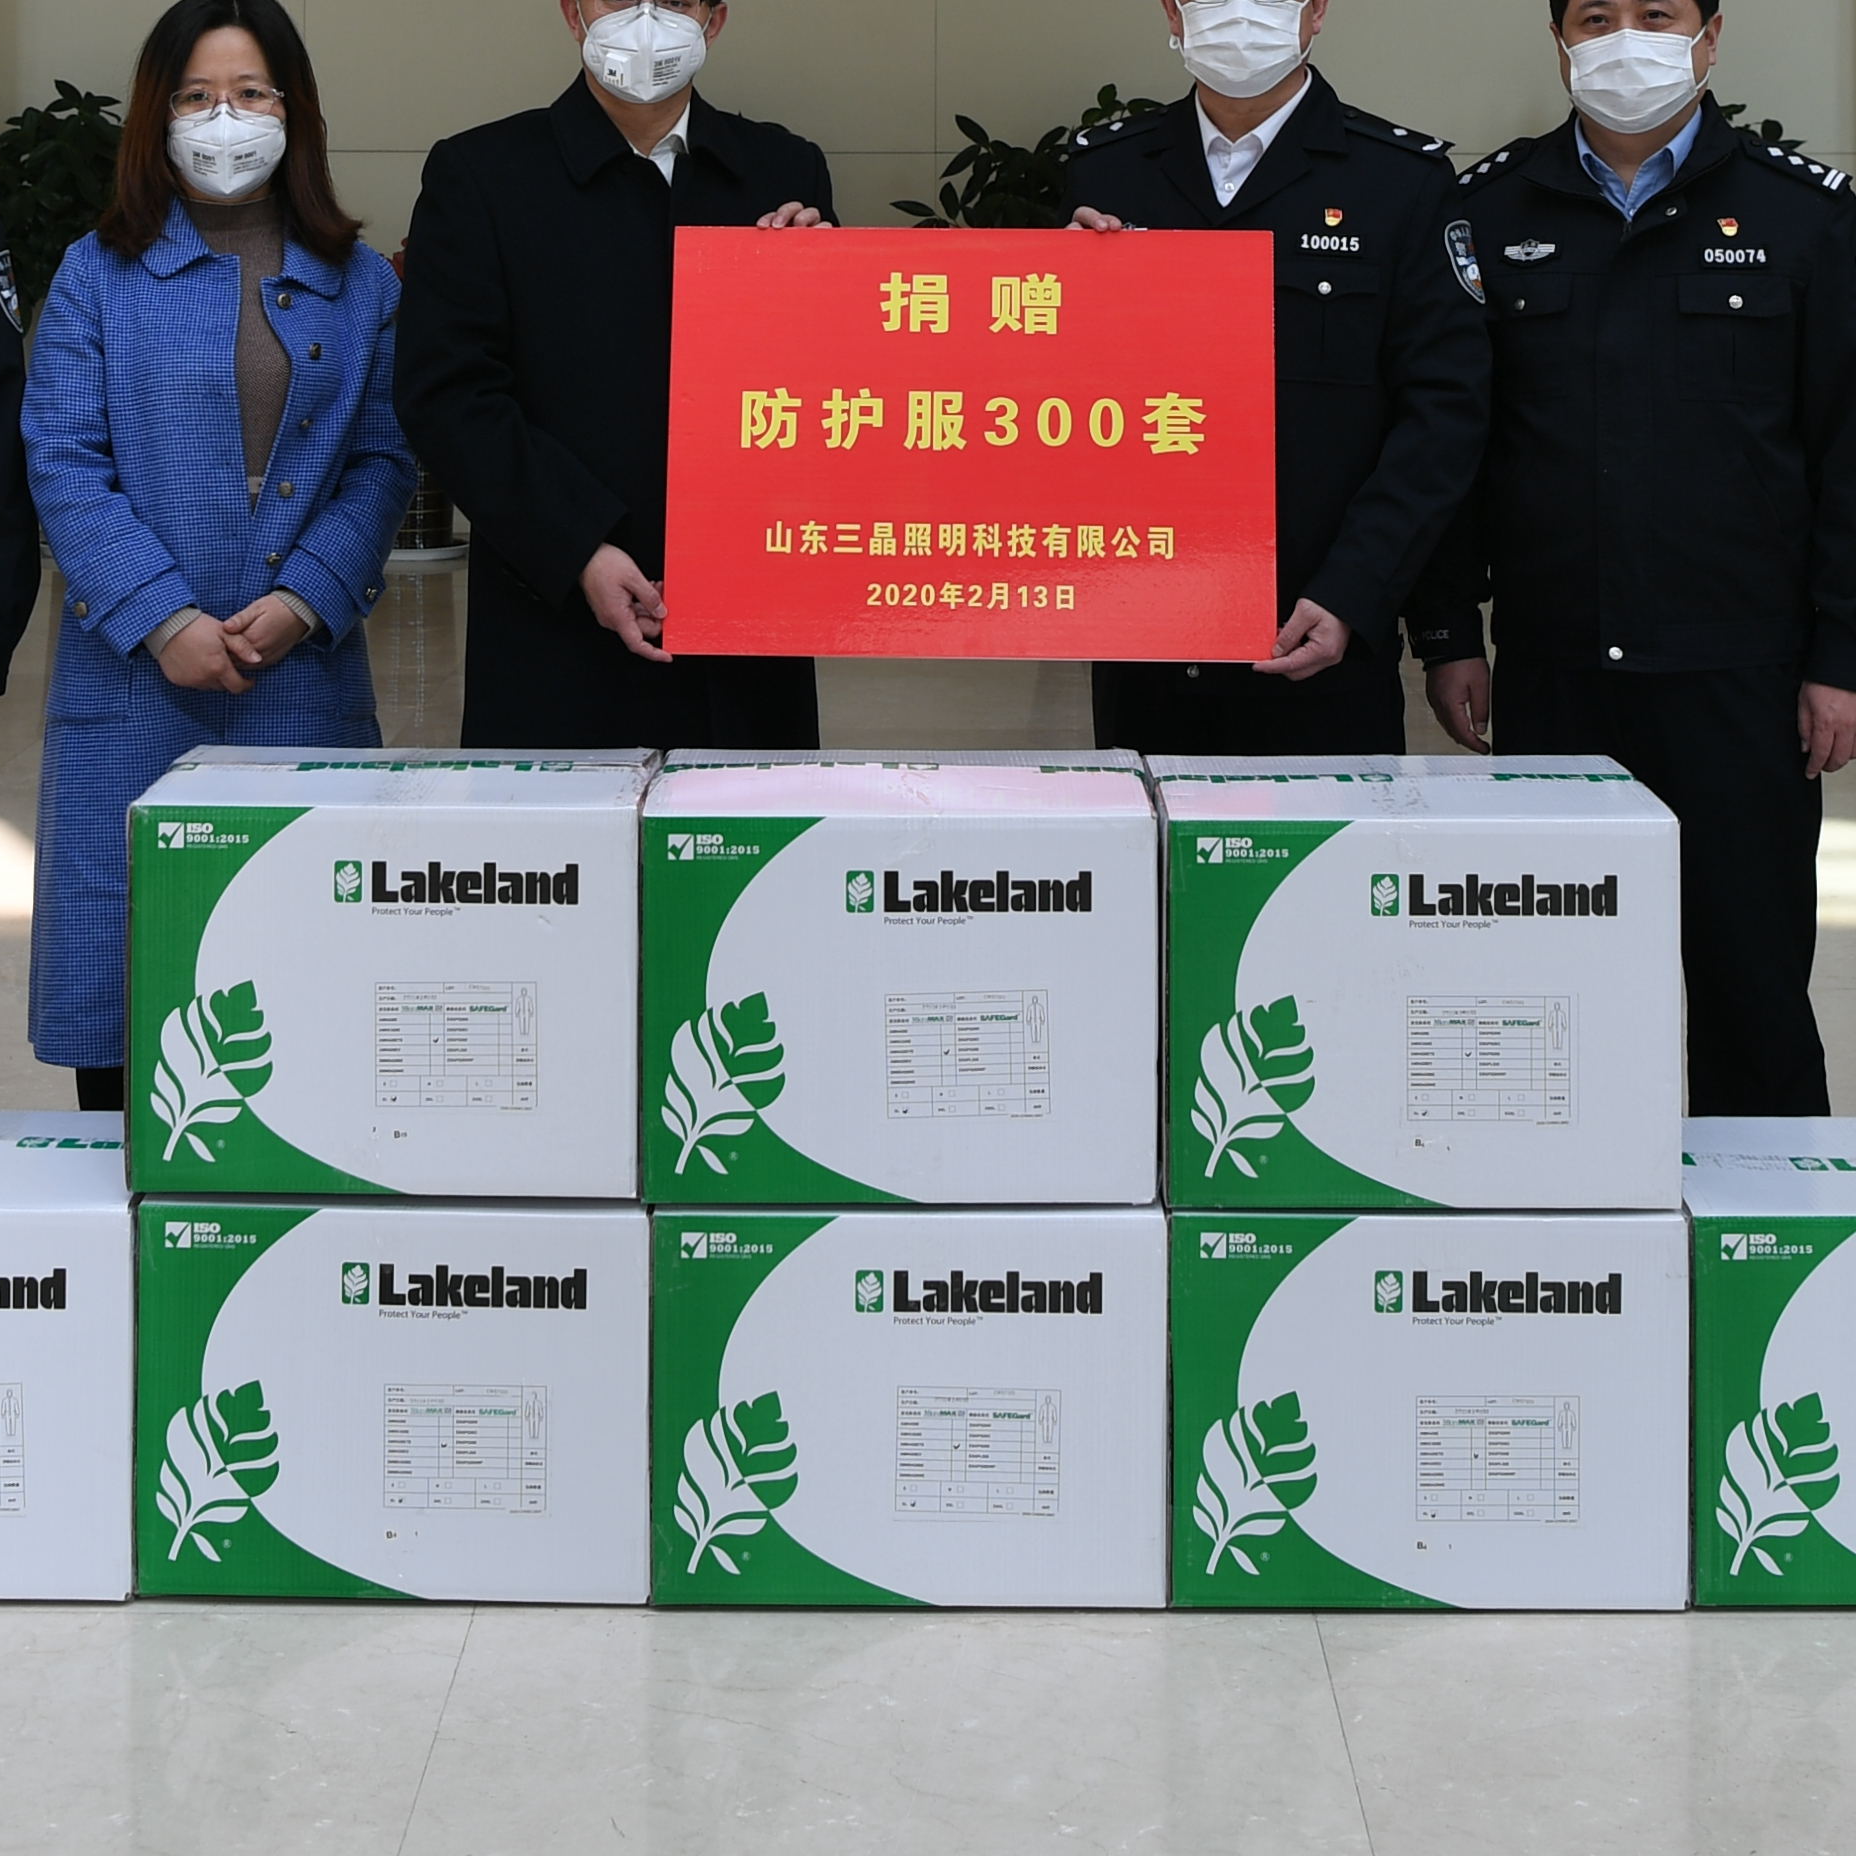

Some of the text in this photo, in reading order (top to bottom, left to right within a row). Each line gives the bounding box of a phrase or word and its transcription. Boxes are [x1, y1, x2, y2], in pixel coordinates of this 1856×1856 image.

[1300, 233, 1360, 252] 100015
[1704, 248, 1766, 263] 050074
[879, 272, 1062, 335] 捐赠
[740, 387, 1206, 455] 防护服300套
[765, 520, 1175, 560] 山东三晶照明科技有限公司
[866, 582, 1076, 611] 2020年2月13日
[186, 823, 213, 834] ISO
[186, 834, 250, 843] 9001:2015
[696, 834, 723, 845] ISO
[1225, 837, 1253, 848] ISO
[696, 845, 760, 855] 9001:2015
[1225, 849, 1289, 858] 9001:2015
[372, 862, 579, 905] Lakeland
[884, 871, 1092, 913] Lakeland
[1409, 874, 1618, 917] Lakeland
[371, 907, 401, 915] Protect
[404, 907, 422, 916] Your
[884, 917, 913, 925] Protect
[916, 917, 935, 925] Your
[1409, 920, 1439, 928] Protect
[1441, 920, 1460, 928] Your
[193, 1223, 221, 1233] ISO
[193, 1234, 257, 1244] 9001:2015
[709, 1233, 737, 1243] ISO
[1228, 1233, 1257, 1244] ISO
[1749, 1234, 1777, 1245] ISO
[709, 1244, 773, 1254] 9001:2015
[1228, 1244, 1293, 1254] 9001:2015
[1749, 1245, 1813, 1255] 9001:2015
[379, 1264, 587, 1310] Lakeland
[894, 1271, 1103, 1314] Lakeland
[1412, 1271, 1622, 1315] Lakeland
[379, 1309, 408, 1318] Protect
[411, 1310, 430, 1318] Your
[893, 1316, 923, 1325] Protect
[926, 1316, 945, 1325] Your
[1412, 1317, 1442, 1325] Protect
[1445, 1317, 1464, 1325] Your
